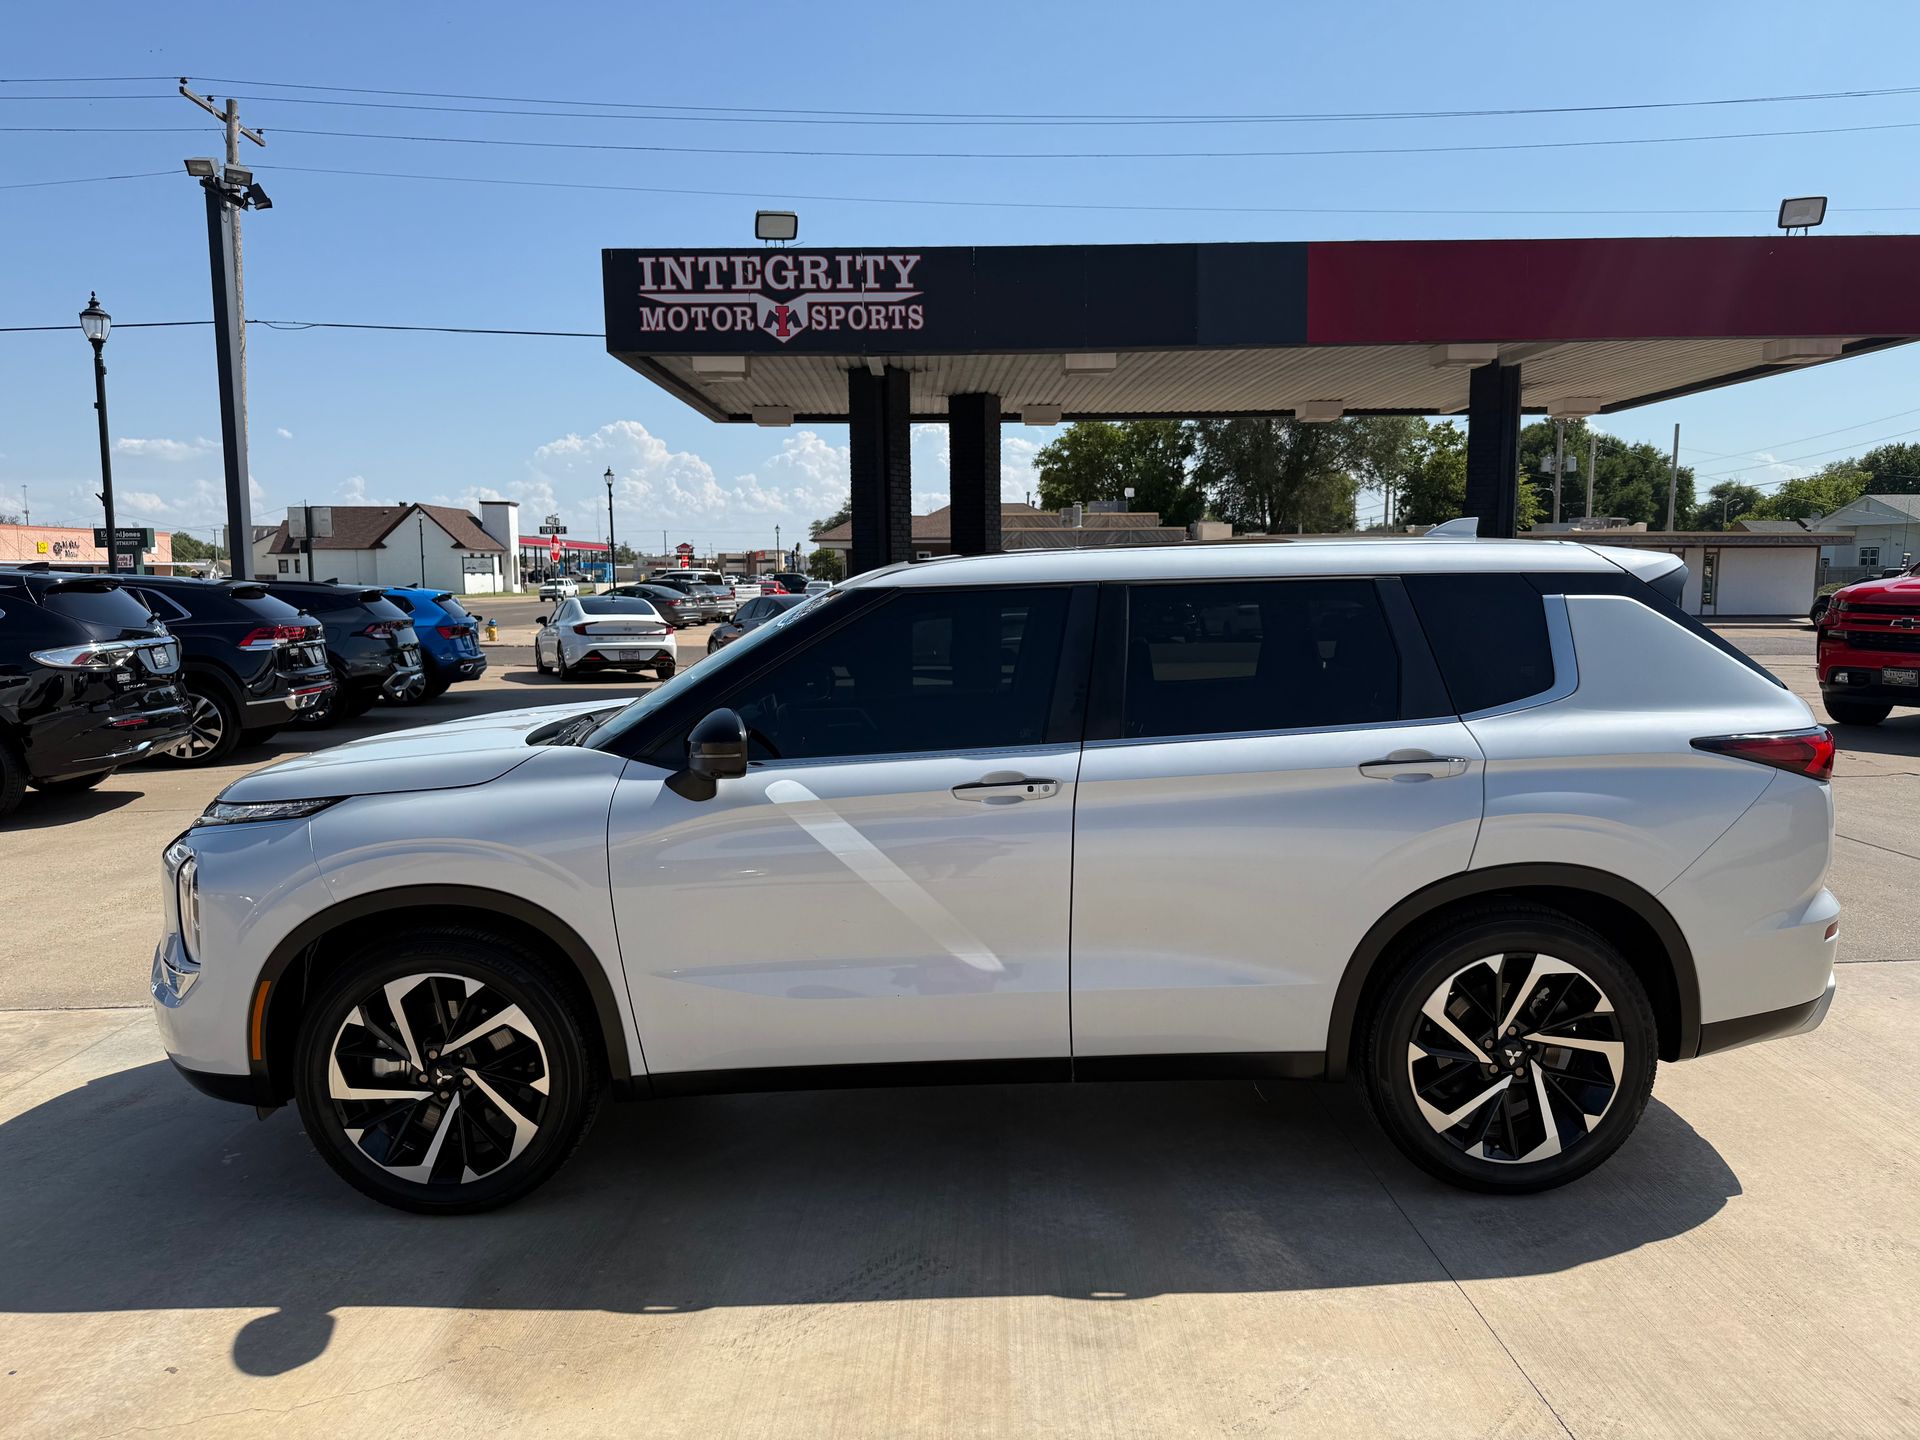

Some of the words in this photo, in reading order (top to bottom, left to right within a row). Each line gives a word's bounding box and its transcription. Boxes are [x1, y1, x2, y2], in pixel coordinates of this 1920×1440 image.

[638, 255, 921, 291] INTEGRITY
[639, 306, 755, 332] MOTOR
[811, 305, 924, 332] SPORTS
[122, 530, 141, 538] Jones
